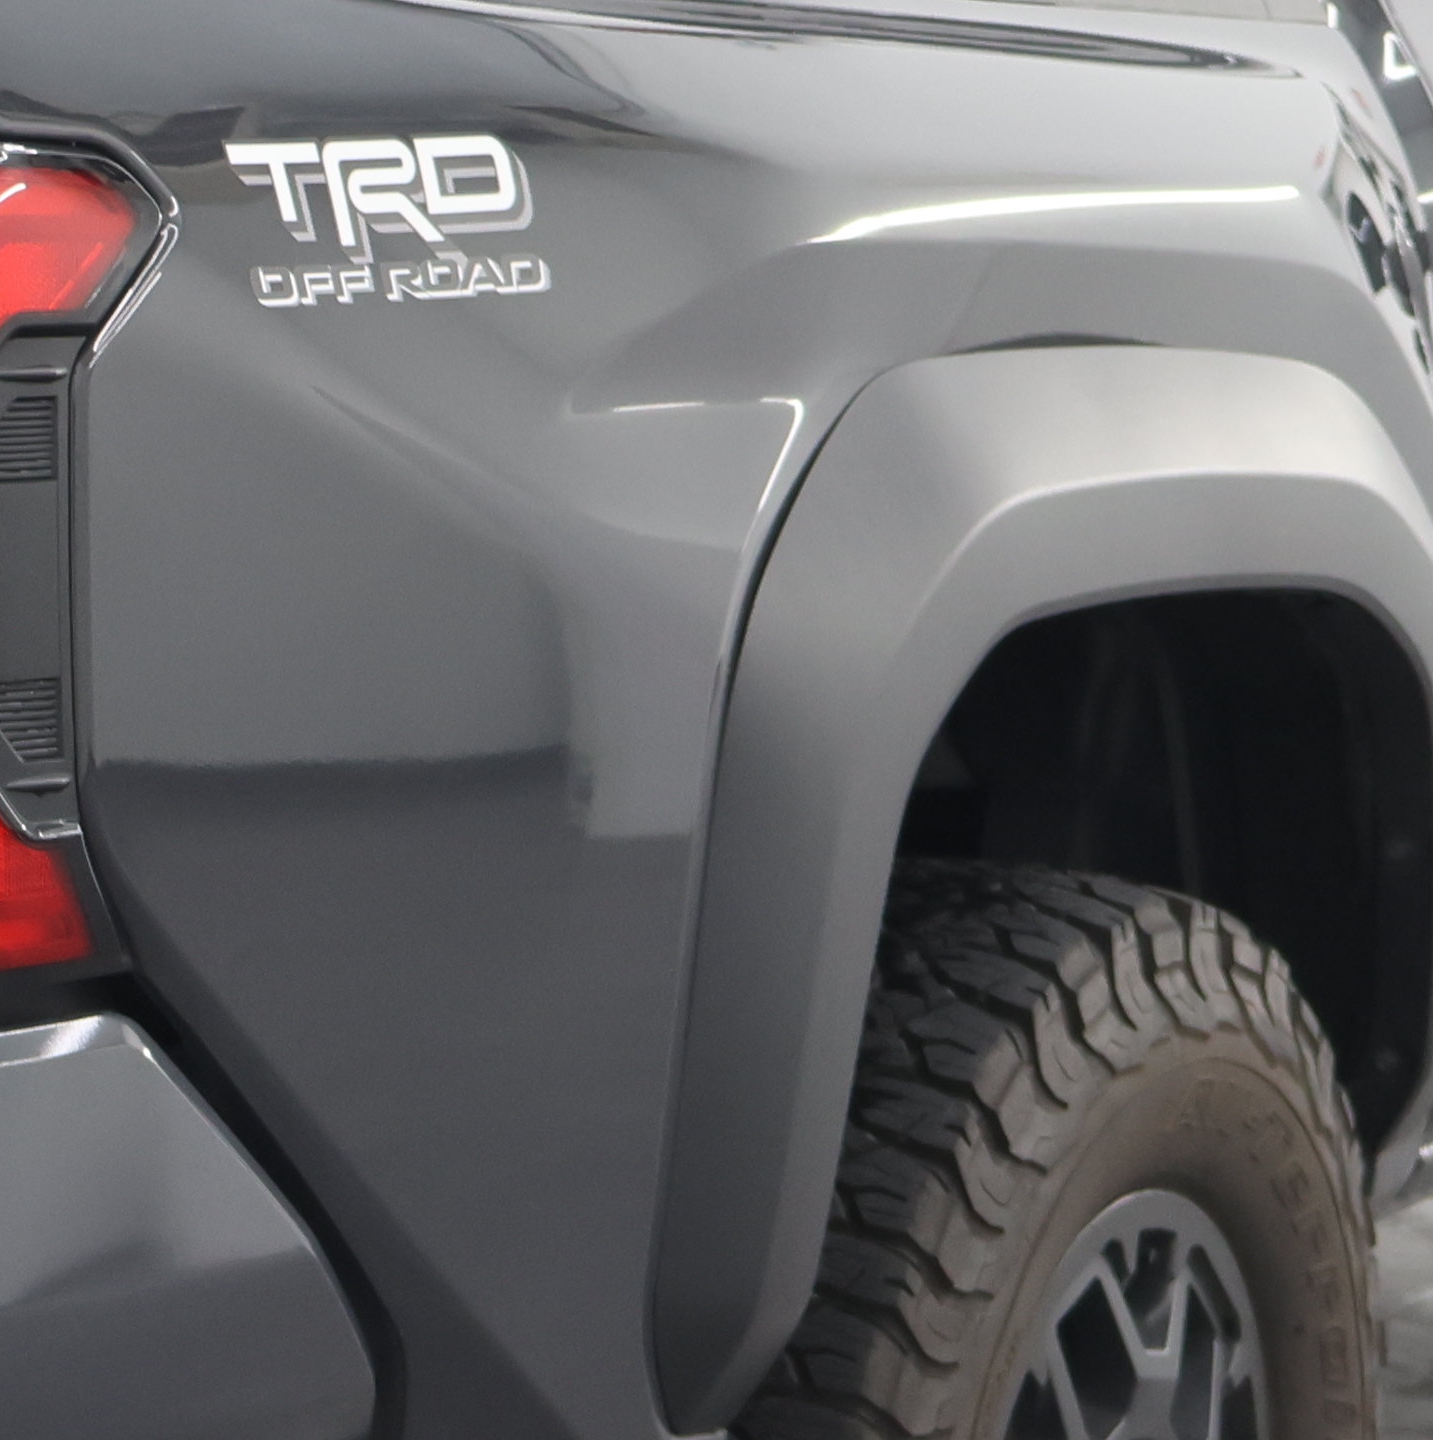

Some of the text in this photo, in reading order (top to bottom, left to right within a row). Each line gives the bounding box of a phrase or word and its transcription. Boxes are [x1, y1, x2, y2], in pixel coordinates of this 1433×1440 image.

[223, 134, 532, 263] TRD
[250, 254, 552, 308] OFF ROAD
